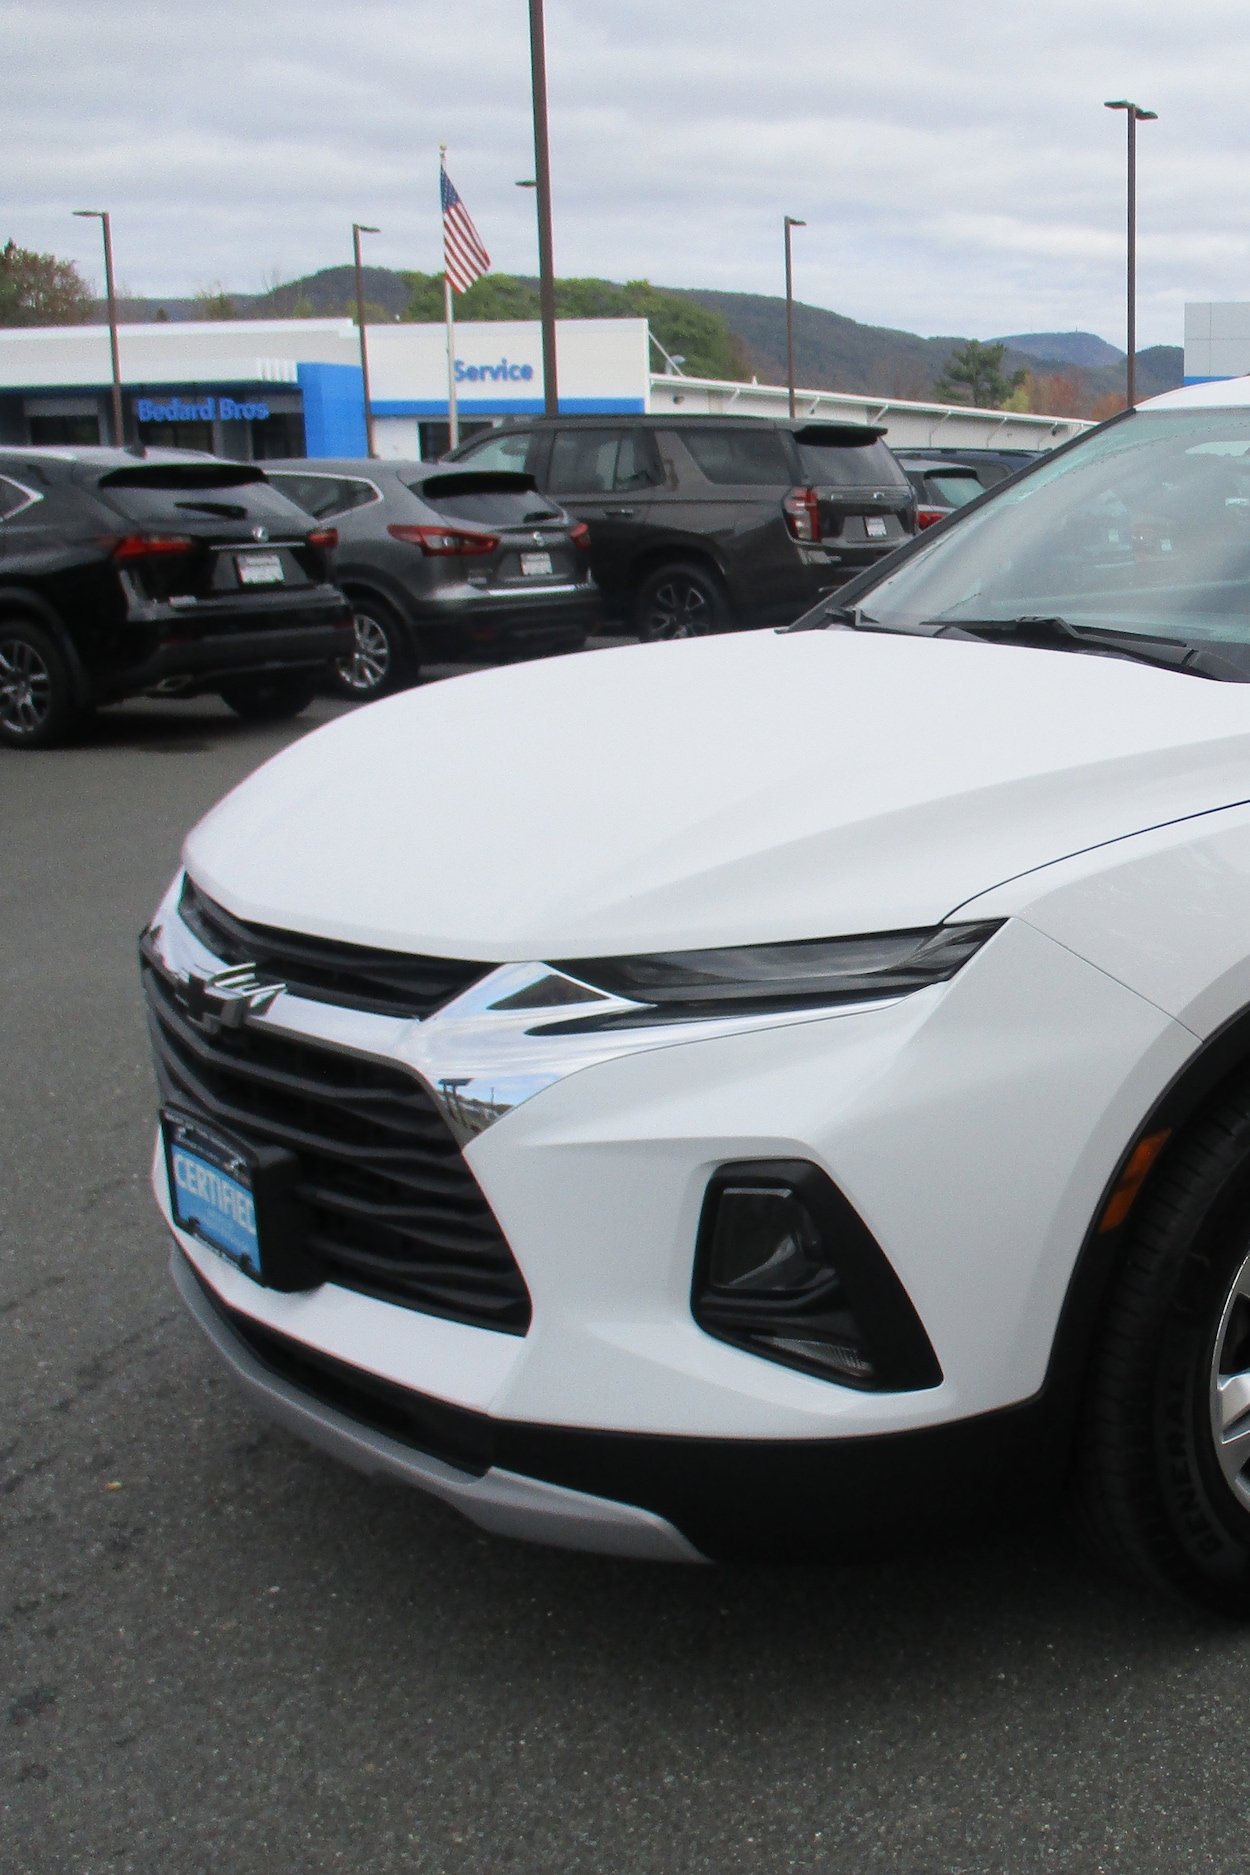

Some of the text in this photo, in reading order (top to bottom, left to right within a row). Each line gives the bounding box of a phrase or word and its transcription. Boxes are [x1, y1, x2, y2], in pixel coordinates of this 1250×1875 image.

[453, 357, 533, 381] Service
[138, 397, 269, 421] Bedard Bros
